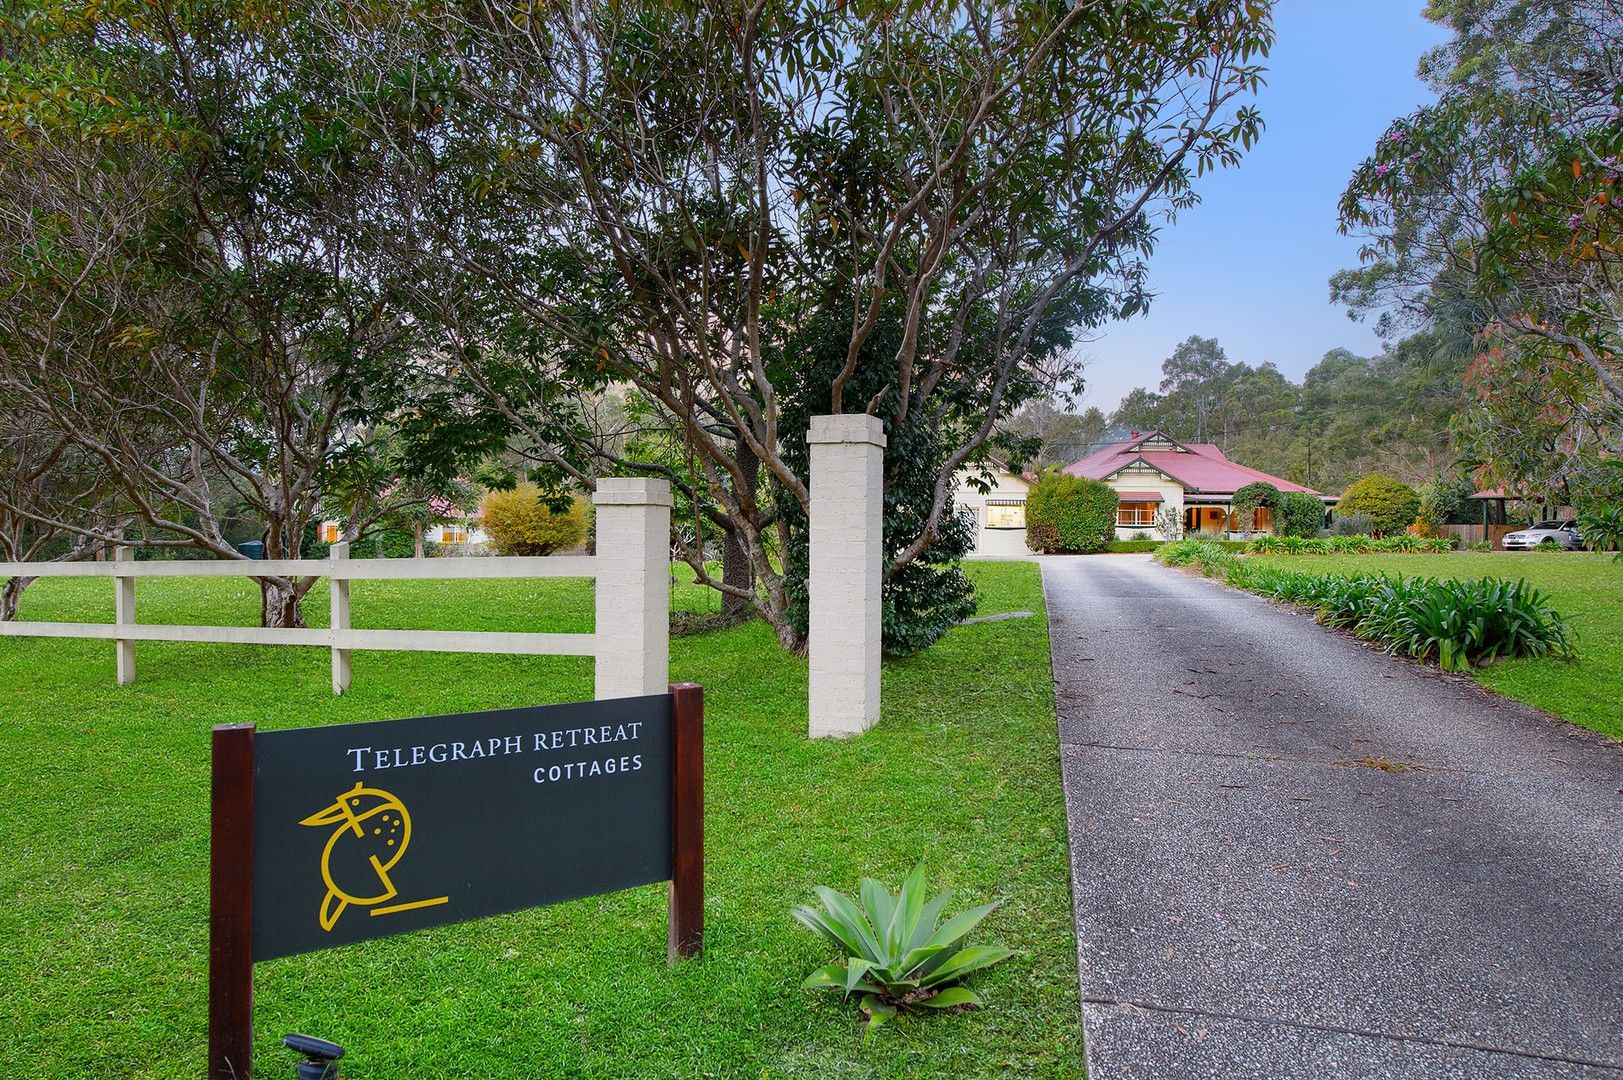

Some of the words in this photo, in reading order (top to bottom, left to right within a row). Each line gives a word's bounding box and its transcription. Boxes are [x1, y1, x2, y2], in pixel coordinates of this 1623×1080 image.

[346, 735, 522, 772] TELEGRAPH
[533, 721, 643, 751] RETREAT
[533, 754, 642, 784] COTTAGES
